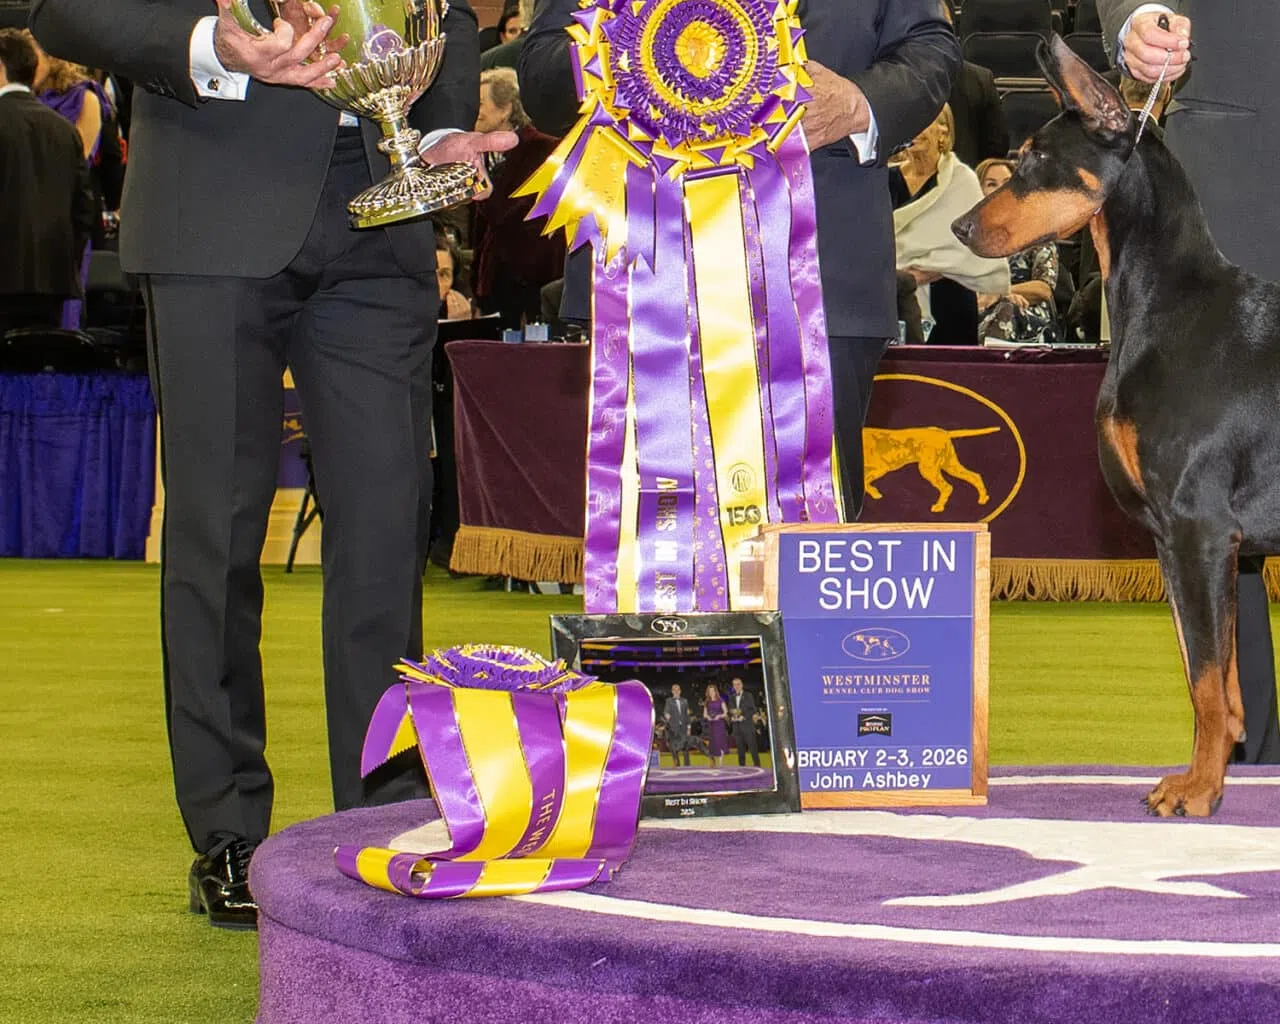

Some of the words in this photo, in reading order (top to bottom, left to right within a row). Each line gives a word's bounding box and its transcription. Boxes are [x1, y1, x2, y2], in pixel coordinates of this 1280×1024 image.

[798, 539, 902, 573] BEST
[923, 539, 956, 572] IN
[818, 577, 935, 610] SHOW
[822, 674, 931, 686] WESTMINSTER
[860, 687, 883, 695] CLUB
[798, 750, 868, 767] BRUARY
[876, 749, 914, 768] 2-3,
[922, 748, 968, 766] 2026
[810, 772, 853, 789] John
[863, 770, 931, 789] Ashbey
[536, 787, 555, 826] THE
